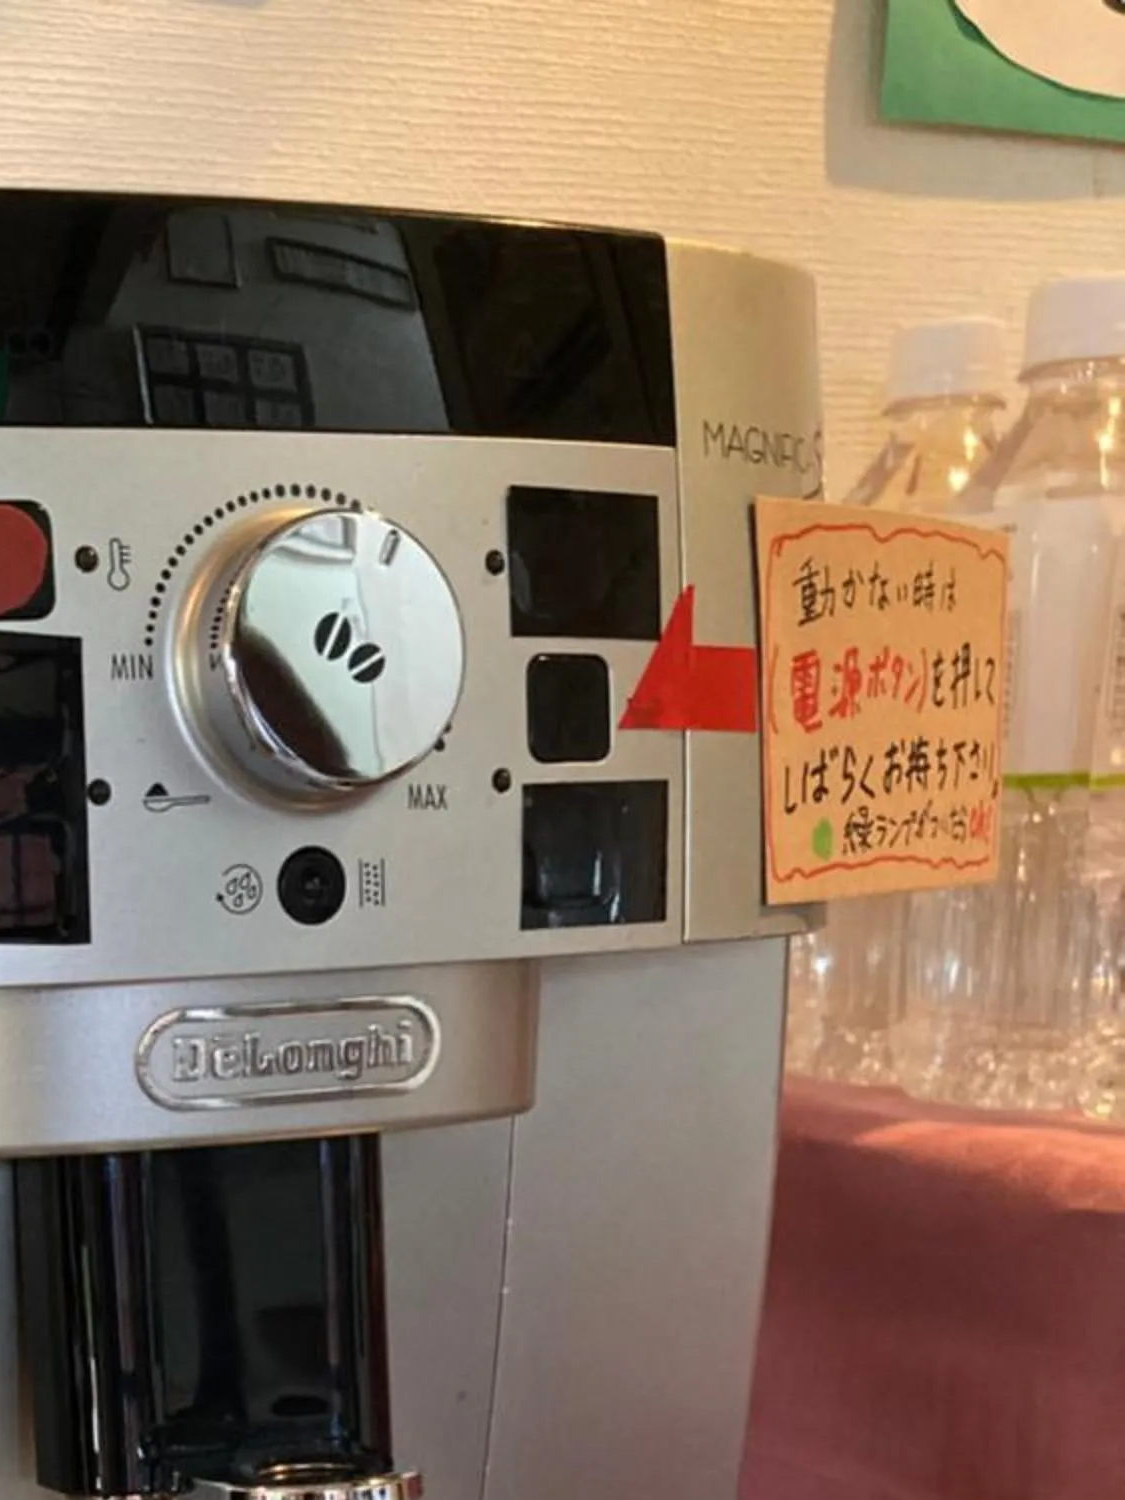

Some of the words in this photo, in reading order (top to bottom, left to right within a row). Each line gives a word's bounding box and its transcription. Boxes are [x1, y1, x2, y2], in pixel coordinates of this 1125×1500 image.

[792, 556, 958, 627] 動かない時は
[111, 653, 154, 680] MIN
[407, 783, 448, 810] MAX
